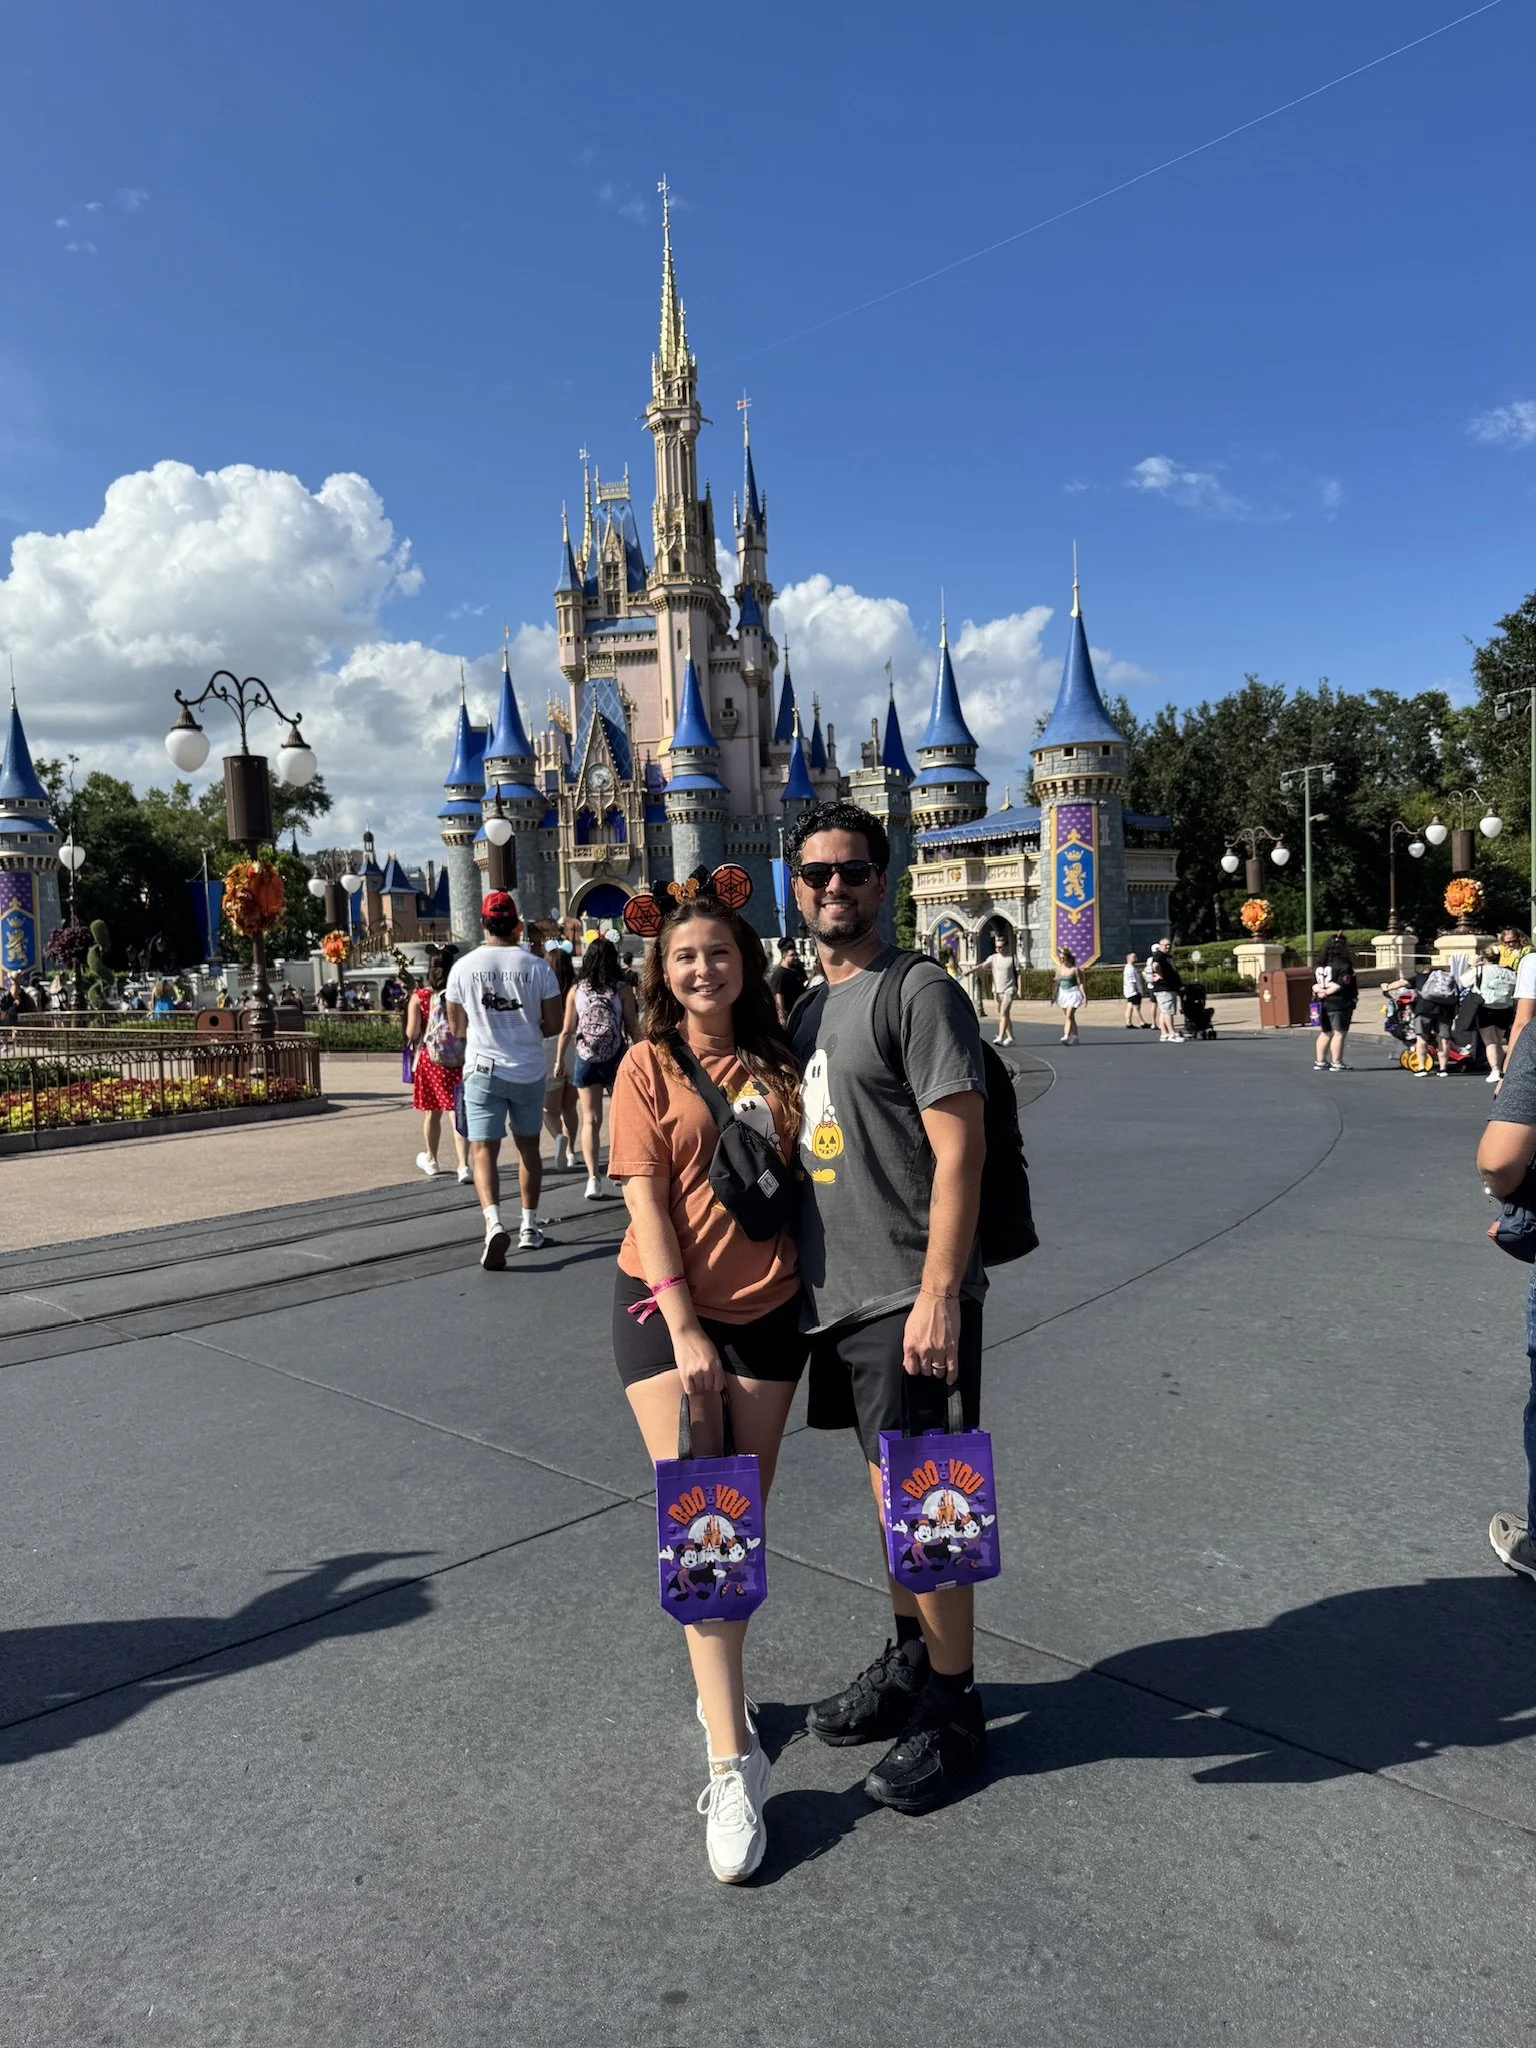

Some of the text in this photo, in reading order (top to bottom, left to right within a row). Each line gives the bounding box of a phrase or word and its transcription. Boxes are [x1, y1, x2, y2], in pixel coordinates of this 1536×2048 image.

[472, 971, 532, 983] RED BULL
[901, 1459, 940, 1501] BOO
[949, 1458, 985, 1495] YOU
[667, 1486, 707, 1526] BOO
[715, 1484, 751, 1520] YOU
